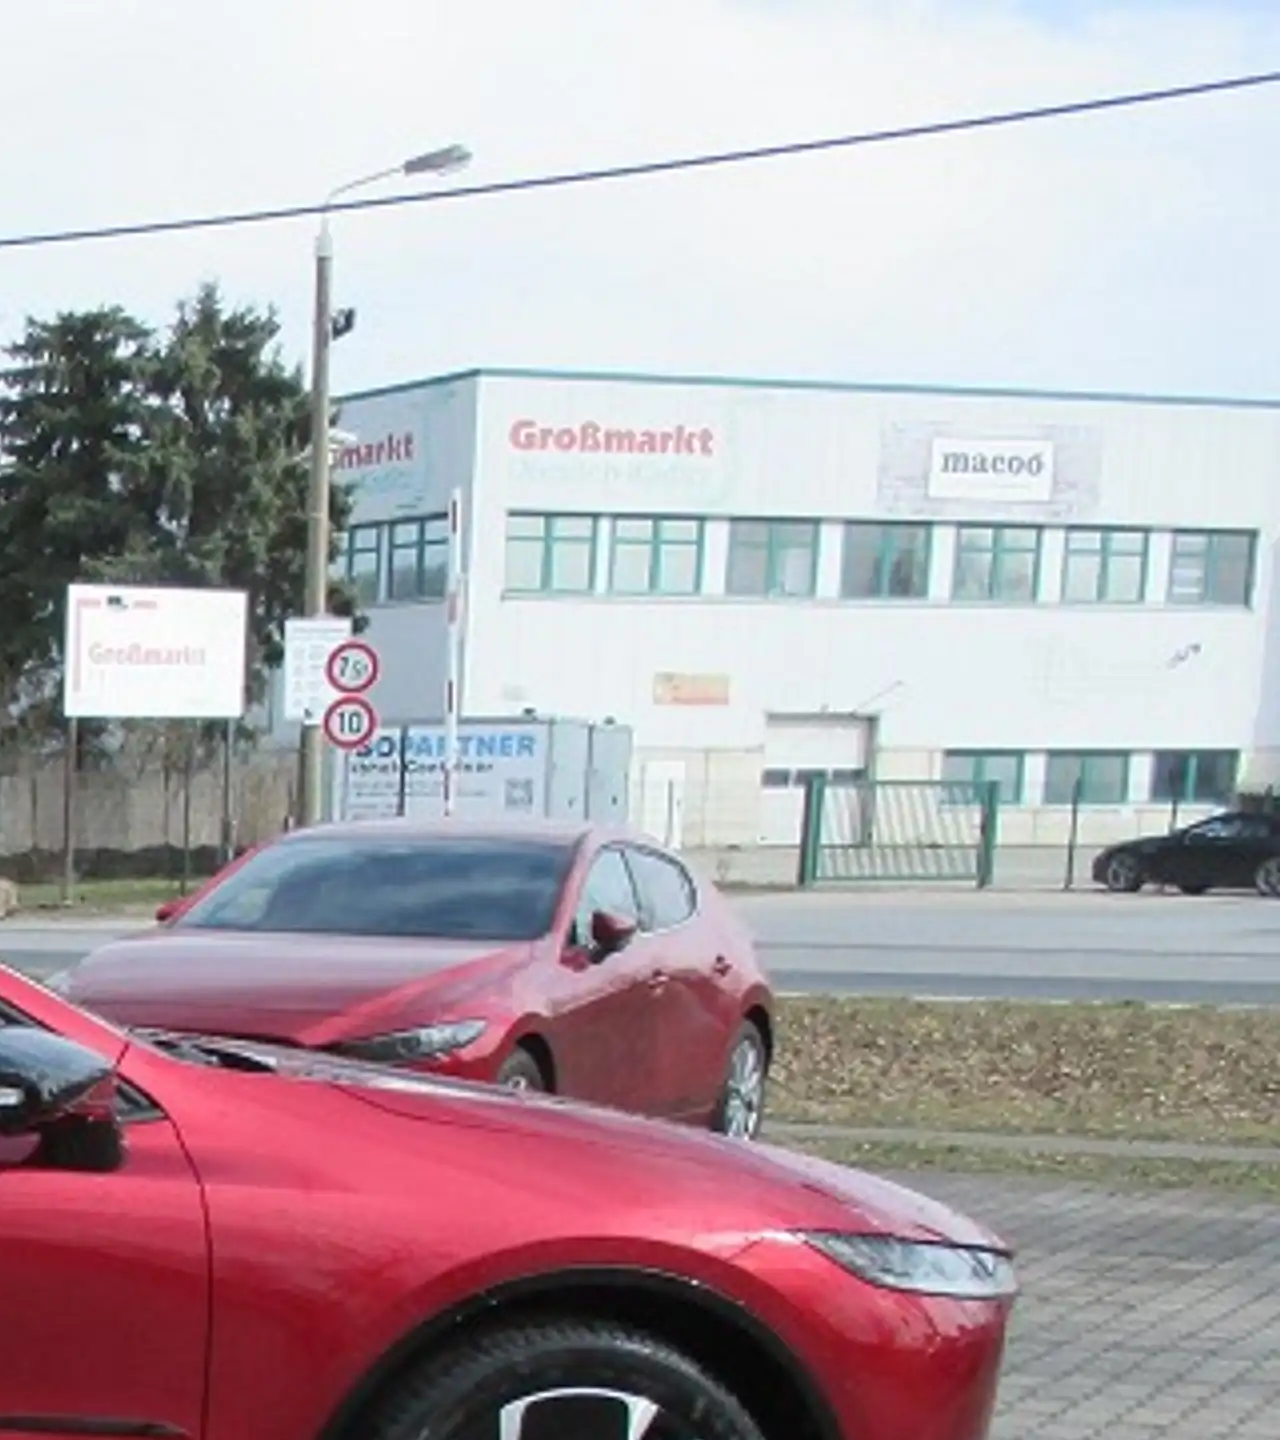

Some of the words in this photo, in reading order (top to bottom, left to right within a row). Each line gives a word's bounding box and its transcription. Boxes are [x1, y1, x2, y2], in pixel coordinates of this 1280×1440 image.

[509, 419, 714, 457] Großmarkt
[89, 642, 207, 666] Großmarkt
[339, 711, 362, 734] 10
